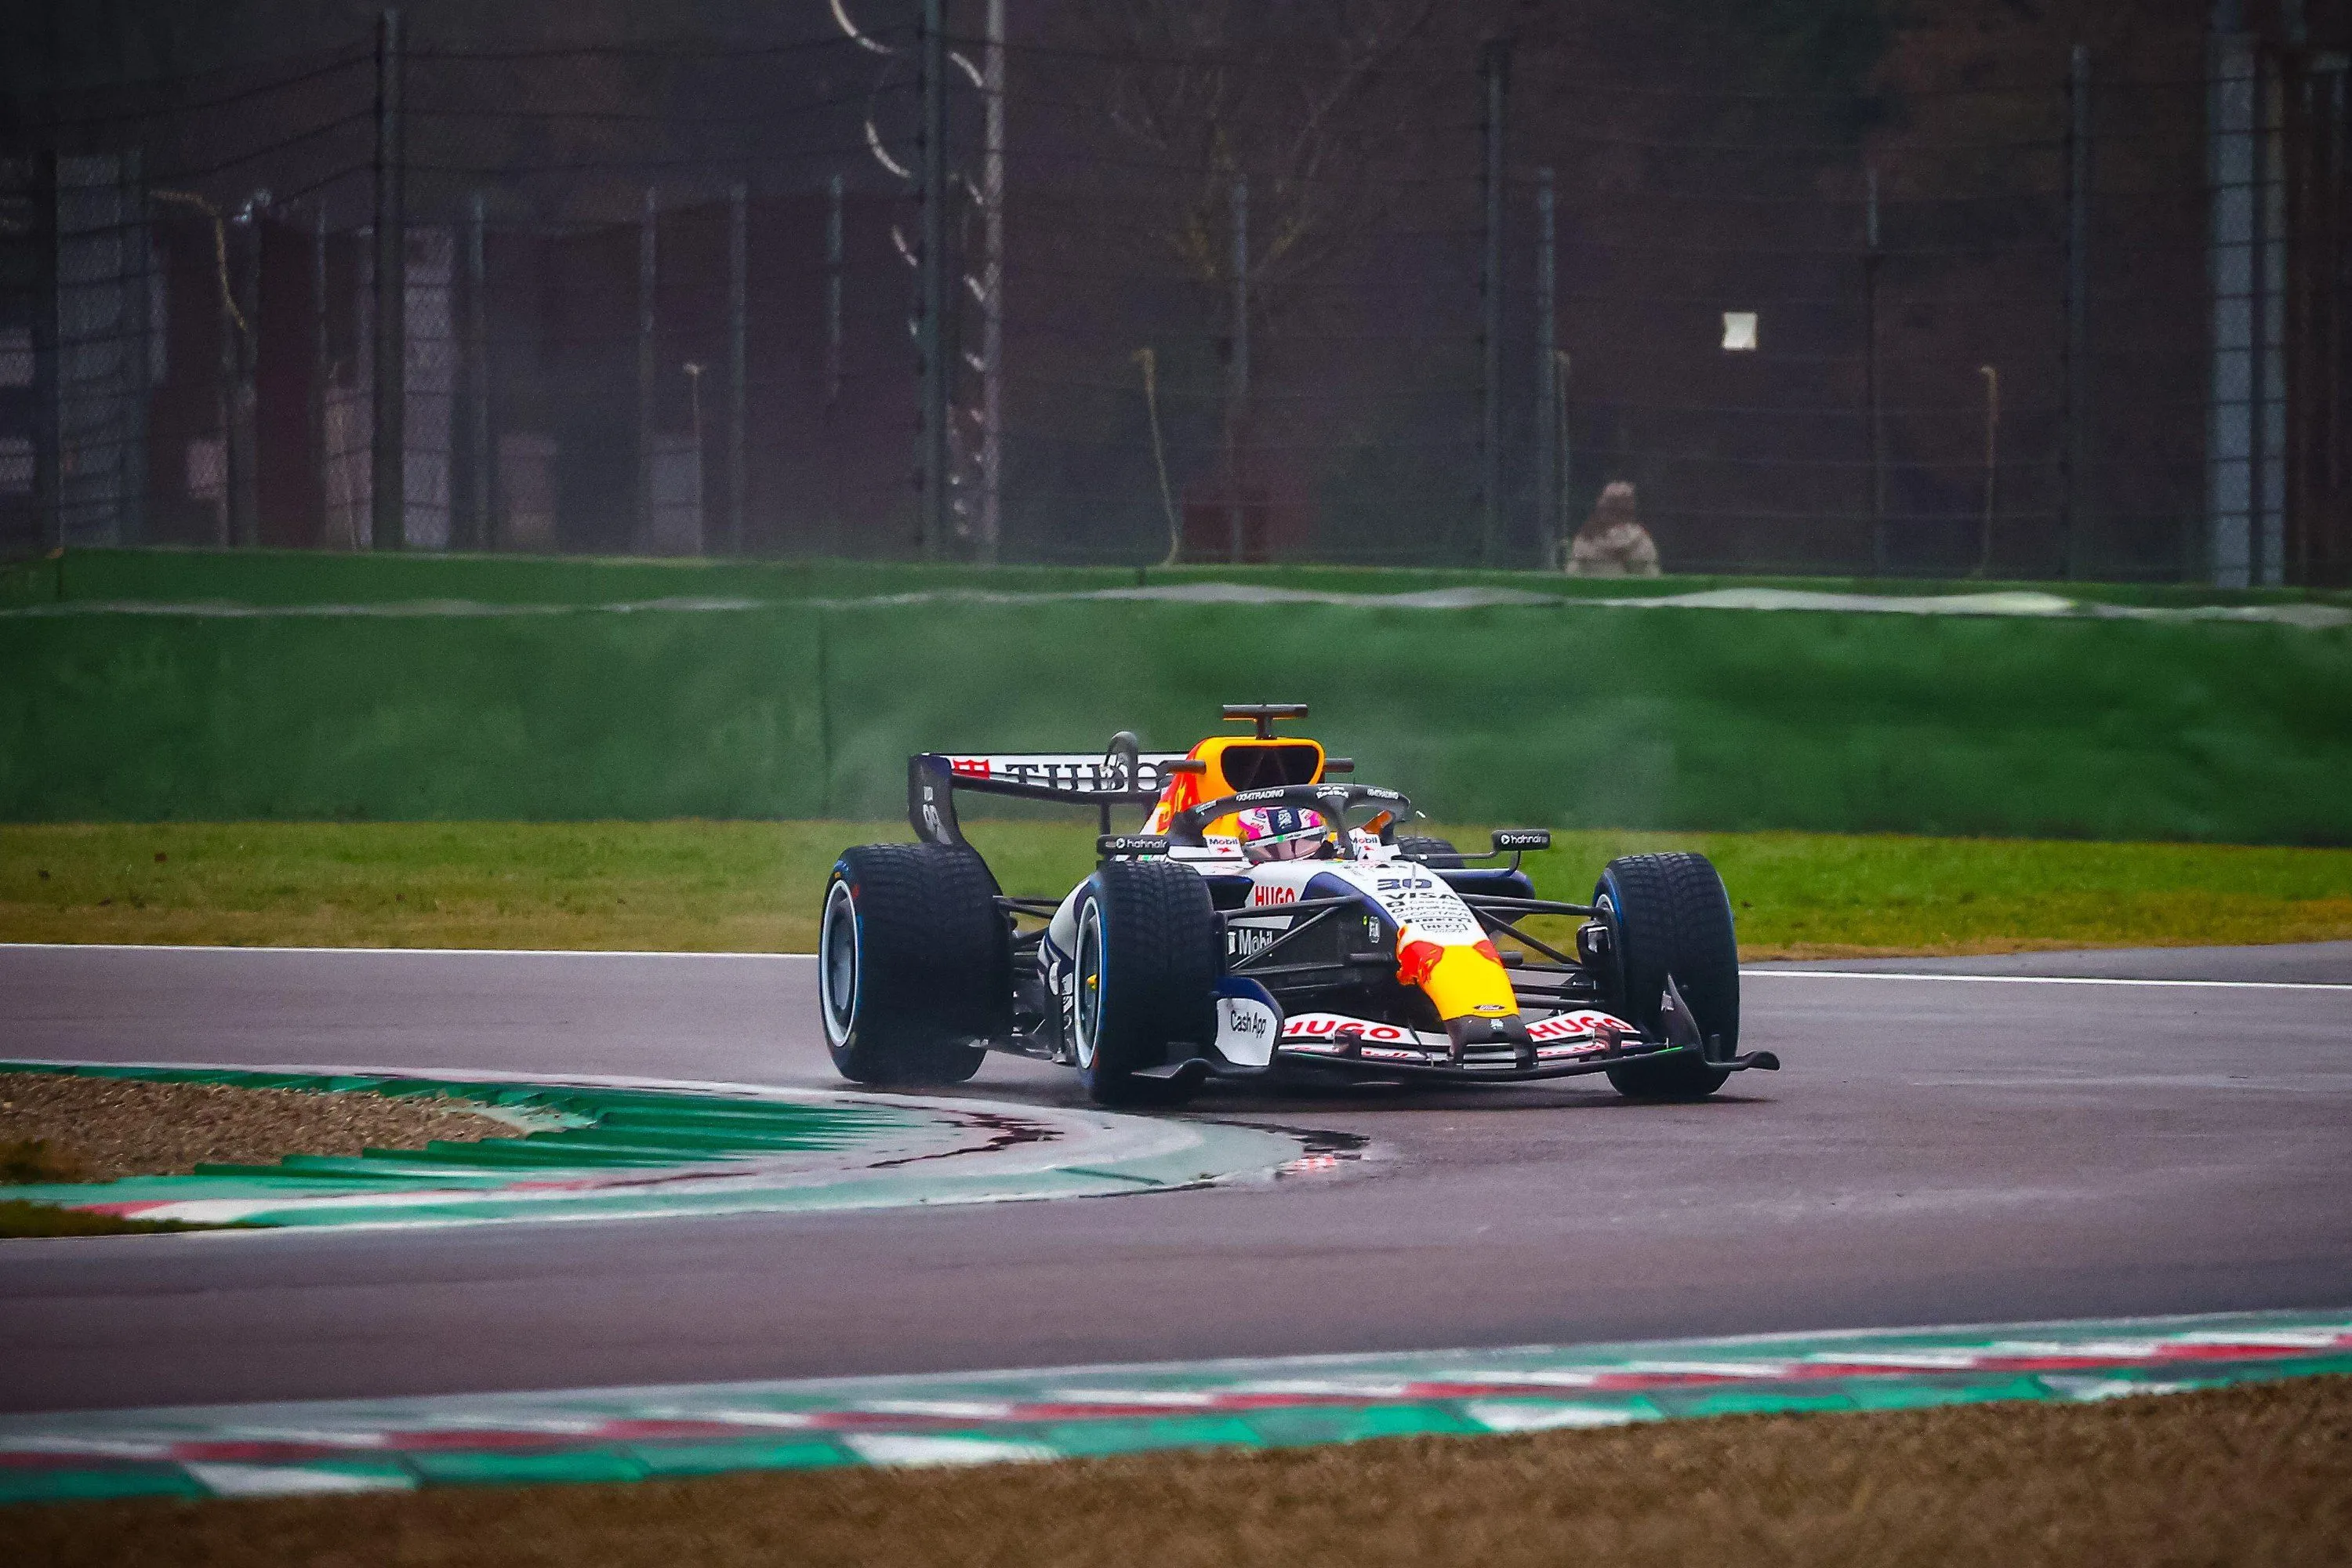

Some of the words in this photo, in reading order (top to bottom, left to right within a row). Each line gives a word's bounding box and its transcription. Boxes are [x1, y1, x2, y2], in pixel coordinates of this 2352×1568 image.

[1005, 763, 1168, 792] TUDO
[1127, 839, 1167, 848] hahnair
[1255, 885, 1295, 906] HUGO
[1381, 893, 1459, 902] VISA
[1239, 929, 1273, 955] Mobil
[1231, 1010, 1250, 1032] Cash
[1252, 1012, 1266, 1038] App
[1283, 1021, 1401, 1039] HUGO
[1526, 1016, 1634, 1038] HUGO
